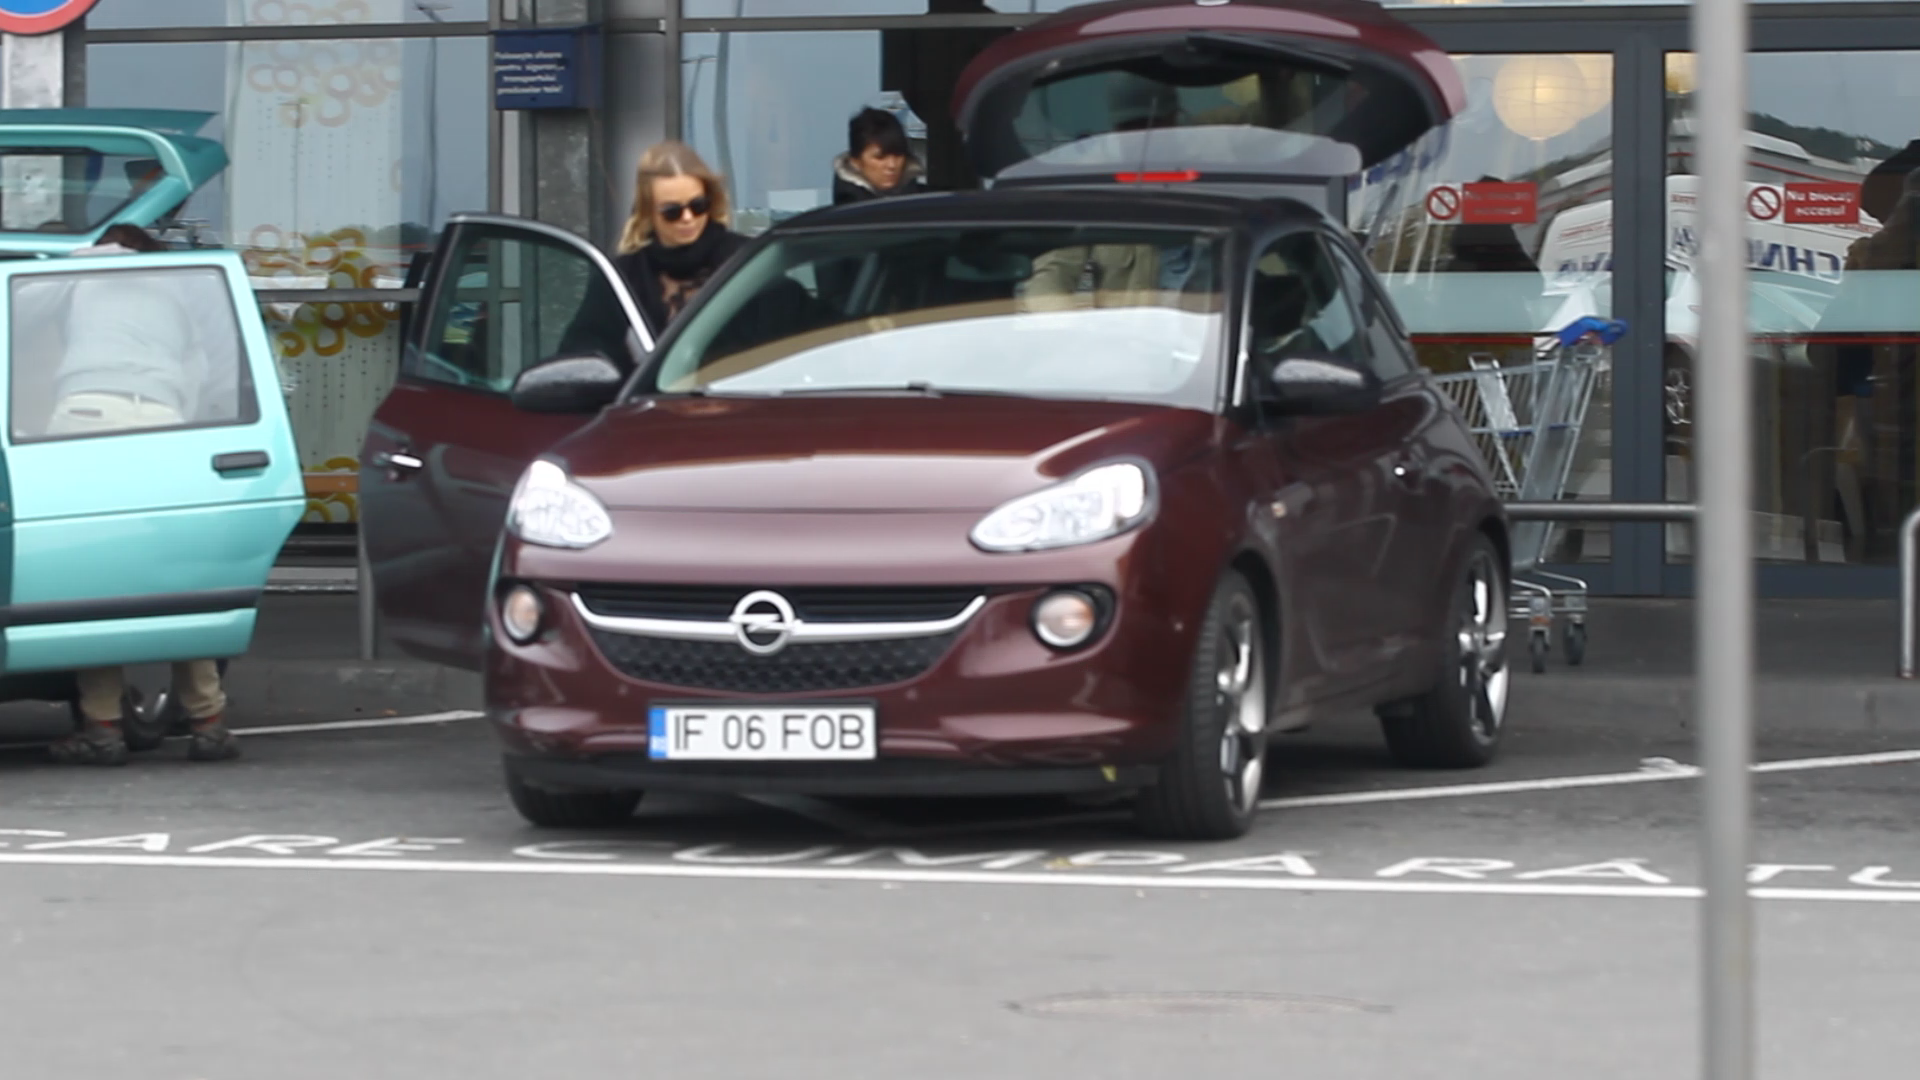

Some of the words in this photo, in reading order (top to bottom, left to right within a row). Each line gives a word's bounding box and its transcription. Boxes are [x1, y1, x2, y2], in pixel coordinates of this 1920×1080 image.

[674, 714, 707, 751] IF
[722, 714, 766, 751] 06
[782, 714, 865, 751] FOB
